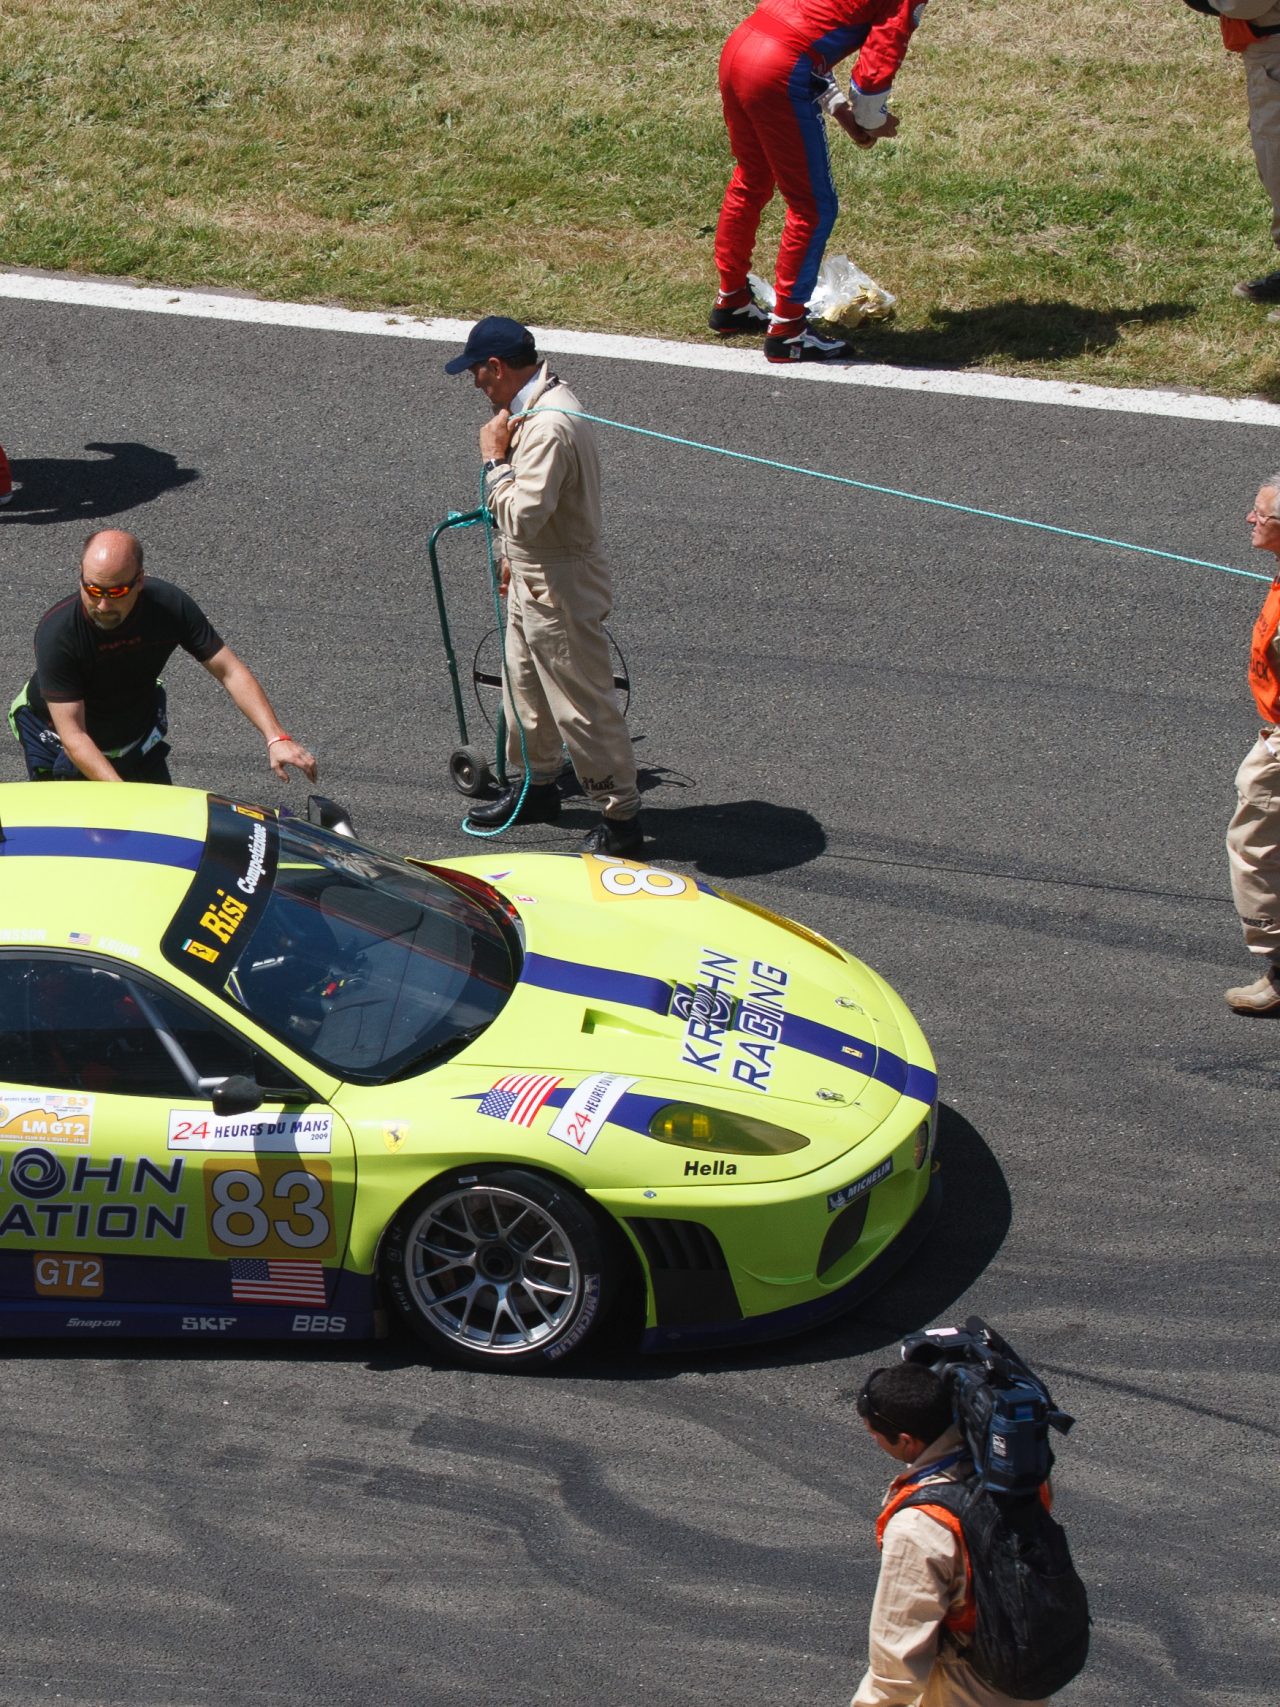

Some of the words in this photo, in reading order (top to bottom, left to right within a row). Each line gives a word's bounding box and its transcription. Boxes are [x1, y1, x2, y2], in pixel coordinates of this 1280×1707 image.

[199, 888, 249, 945] Risi
[236, 822, 267, 895] Competizione
[596, 856, 686, 897] 8
[730, 960, 789, 1092] RACING
[172, 1121, 211, 1142] 24
[214, 1123, 264, 1139] HEURES
[267, 1122, 286, 1135] DU
[290, 1119, 330, 1133] MANS
[566, 1111, 593, 1146] 24
[583, 1084, 609, 1115] HEURES
[310, 1132, 329, 1142] 2009
[683, 1160, 738, 1177] Hella
[847, 1158, 891, 1199] MICHELIN
[210, 1169, 332, 1250] 83
[36, 1258, 101, 1287] GT2
[66, 1318, 122, 1329] Snap-on
[181, 1317, 238, 1331] SKF
[291, 1314, 348, 1333] BBS
[550, 1297, 600, 1360] MICHELIN
